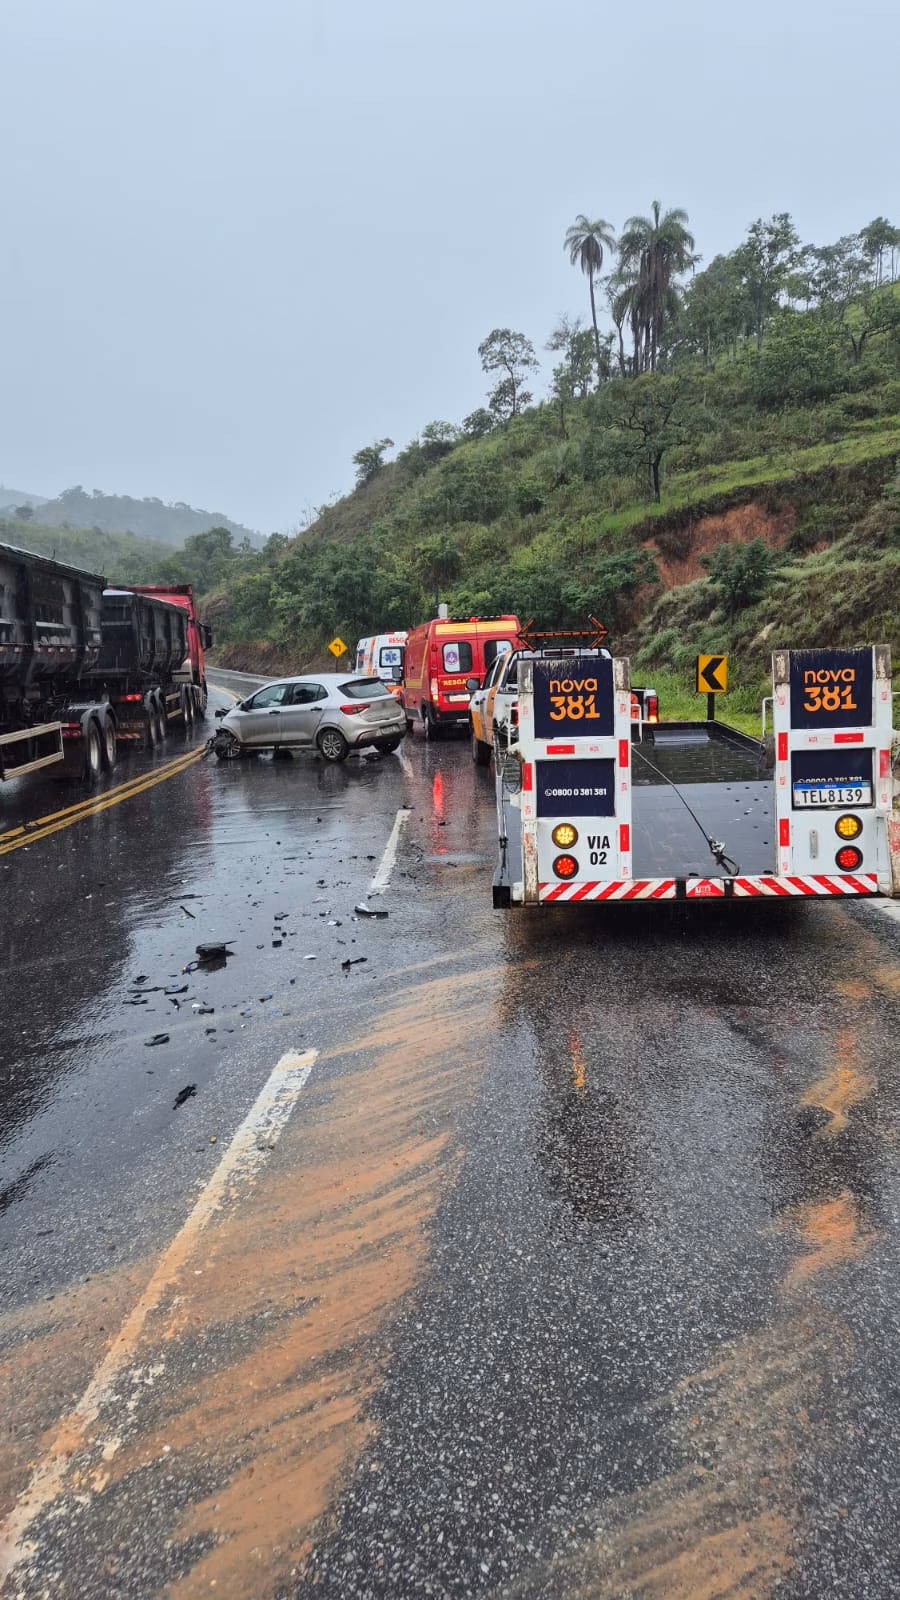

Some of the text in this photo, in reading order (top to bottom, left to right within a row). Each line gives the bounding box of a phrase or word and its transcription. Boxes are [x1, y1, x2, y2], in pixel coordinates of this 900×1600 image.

[443, 678, 467, 686] RESGA
[804, 668, 855, 684] nova
[549, 678, 598, 693] nova
[803, 685, 857, 712] 381
[549, 694, 601, 720] 381
[552, 788, 607, 796] 0800 0 381 381
[801, 789, 863, 804] TEL8I39
[587, 835, 611, 849] VIA
[590, 851, 607, 865] 02
